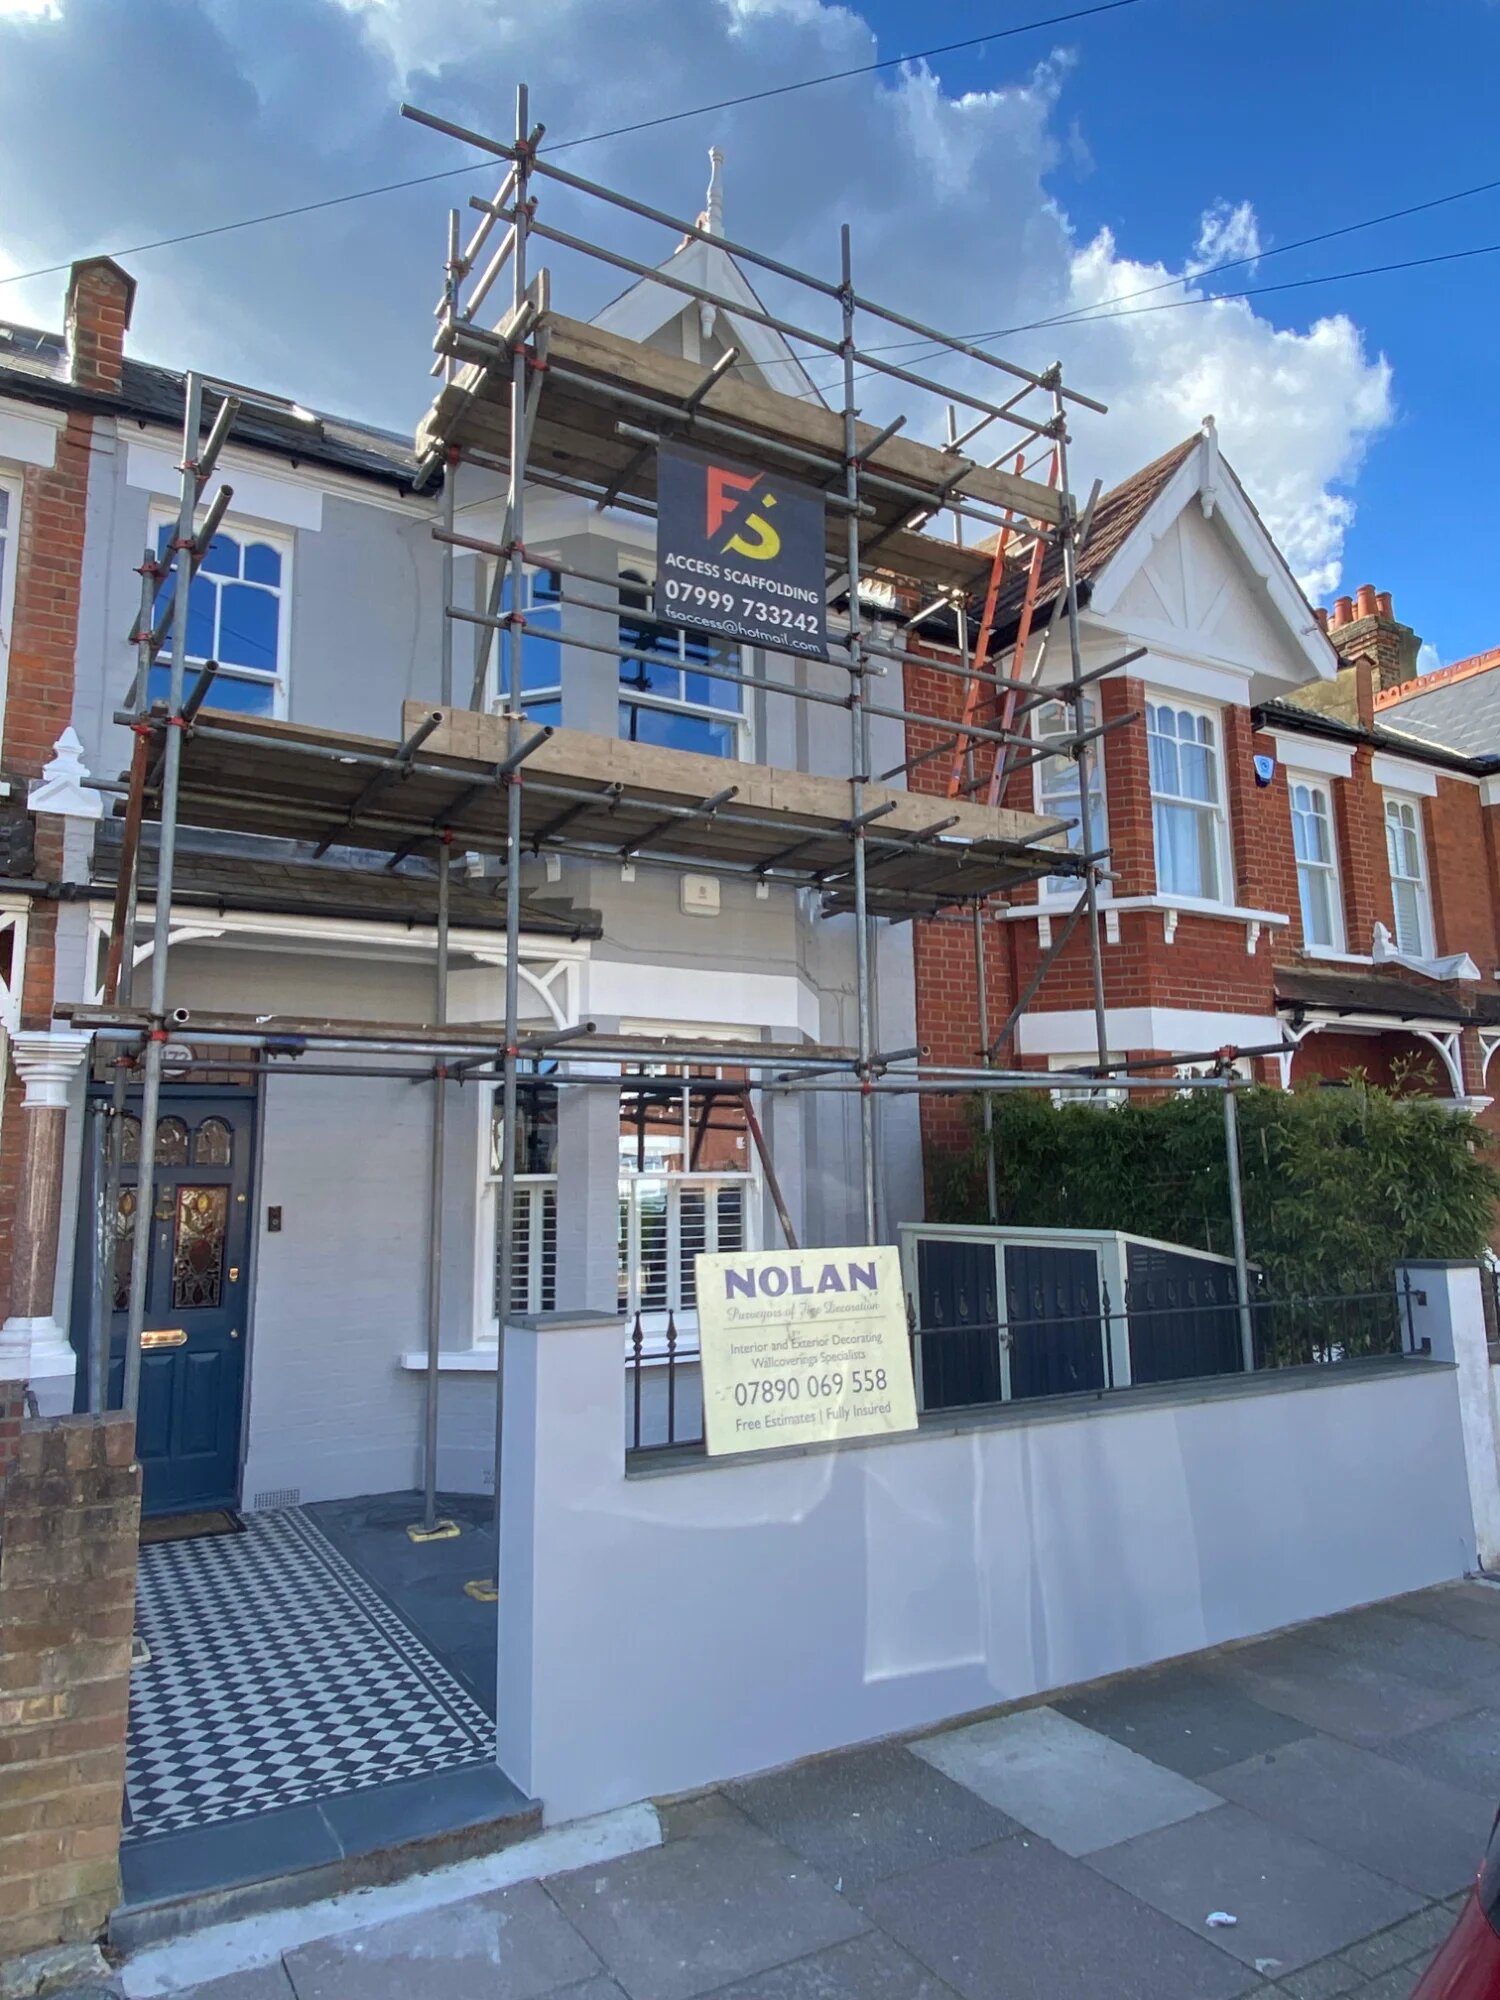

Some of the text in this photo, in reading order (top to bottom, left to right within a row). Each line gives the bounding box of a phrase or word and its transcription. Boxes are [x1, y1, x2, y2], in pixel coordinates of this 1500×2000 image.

[665, 553, 819, 604] ACCESS SCAFFOLDING
[665, 579, 819, 635] 07999 733242
[664, 604, 821, 653] fsaccess@hotmail.com
[724, 1261, 878, 1299] NOLAN
[785, 1303, 795, 1320] of
[823, 1300, 880, 1314] Decoration
[730, 1332, 883, 1355] Interior and Exterior Decorating
[752, 1350, 866, 1369] Wallcoverings Specialists
[734, 1368, 887, 1406] 07890 069 558
[735, 1418, 762, 1432] Free
[764, 1413, 816, 1428] Estimates
[826, 1406, 850, 1421] Fully
[853, 1401, 891, 1416] Insured
